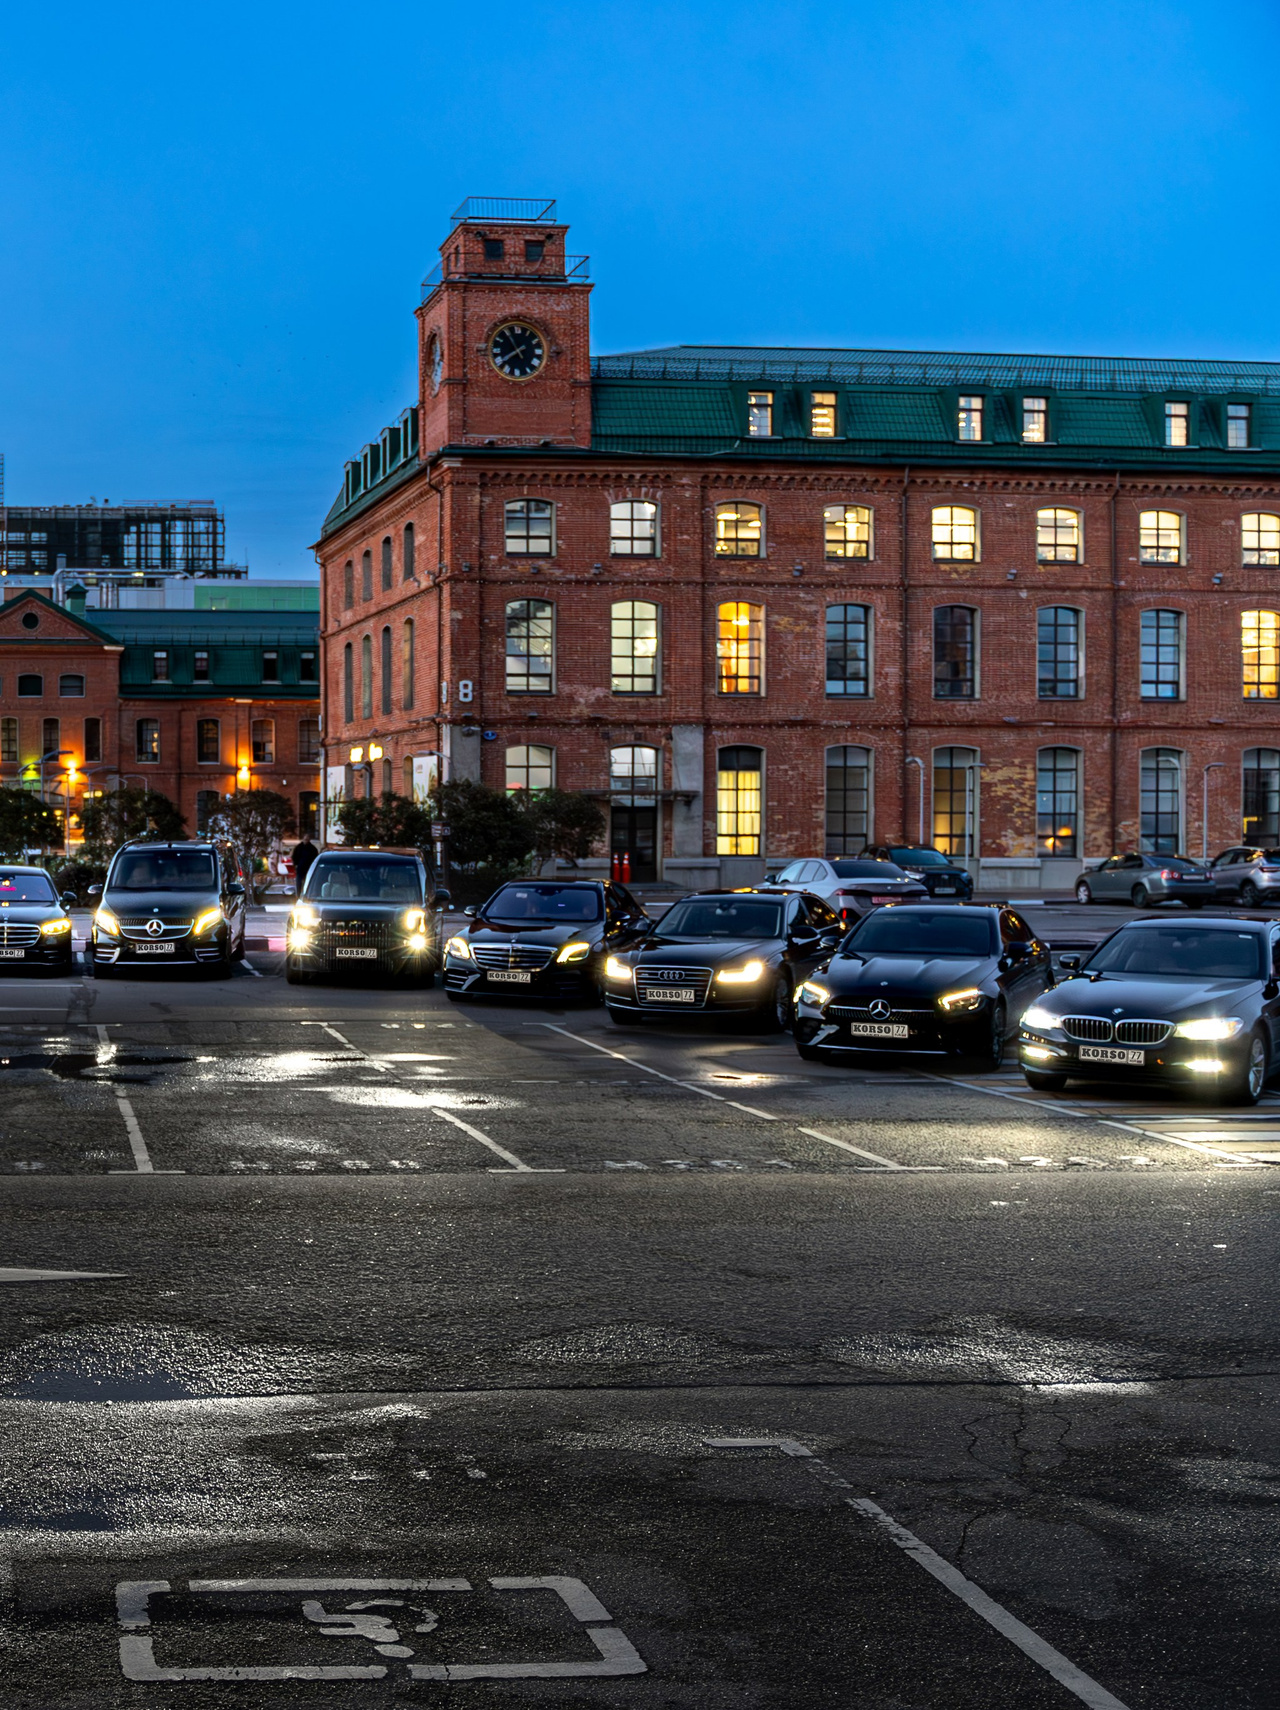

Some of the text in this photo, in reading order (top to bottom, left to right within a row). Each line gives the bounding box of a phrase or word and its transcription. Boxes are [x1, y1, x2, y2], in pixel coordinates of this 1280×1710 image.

[459, 680, 473, 702] 8
[853, 1025, 891, 1034] KORSO
[1082, 1048, 1141, 1060] KORSO 77
